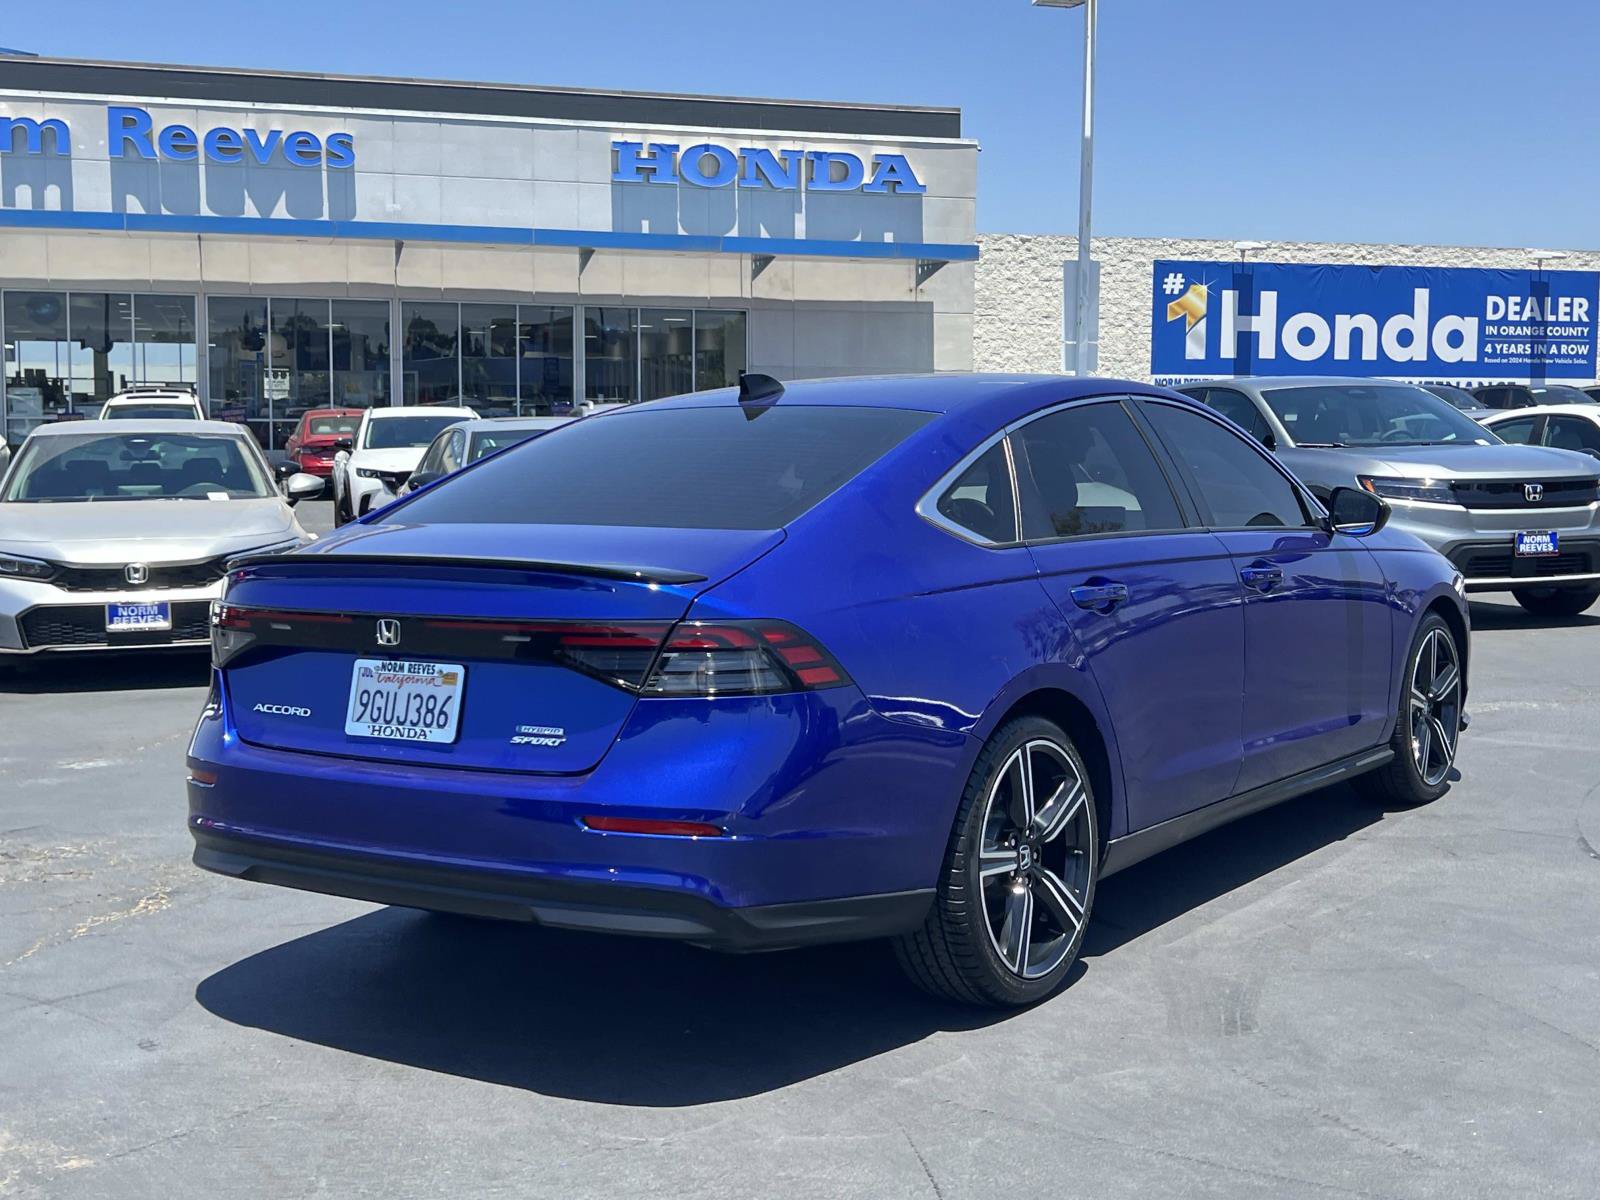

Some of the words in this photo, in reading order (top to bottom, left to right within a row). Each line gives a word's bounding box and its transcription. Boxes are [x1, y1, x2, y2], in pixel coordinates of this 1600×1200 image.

[107, 106, 356, 168] Reeves
[612, 141, 926, 193] HONDA
[1486, 295, 1590, 322] DEALER
[1162, 272, 1207, 360] #1
[1220, 287, 1479, 363] Honda
[1485, 326, 1497, 336] IN
[1500, 326, 1545, 336] ORANGE
[1547, 327, 1590, 337] COUNTY
[1484, 343, 1493, 354] 4
[1495, 344, 1532, 355] YEARS
[1534, 344, 1547, 355] IN
[1549, 344, 1558, 355] A
[1560, 345, 1590, 355] ROW
[1523, 535, 1551, 544] NORM
[1519, 543, 1554, 552] REEVES
[118, 605, 158, 616] NORM
[380, 662, 405, 673] NORM
[407, 664, 436, 675] REEVES
[377, 673, 441, 689] California
[253, 703, 311, 717] ACCORD
[355, 689, 453, 730] 9GUJ386
[370, 725, 428, 740] HONDA
[509, 735, 567, 746] SPORT
